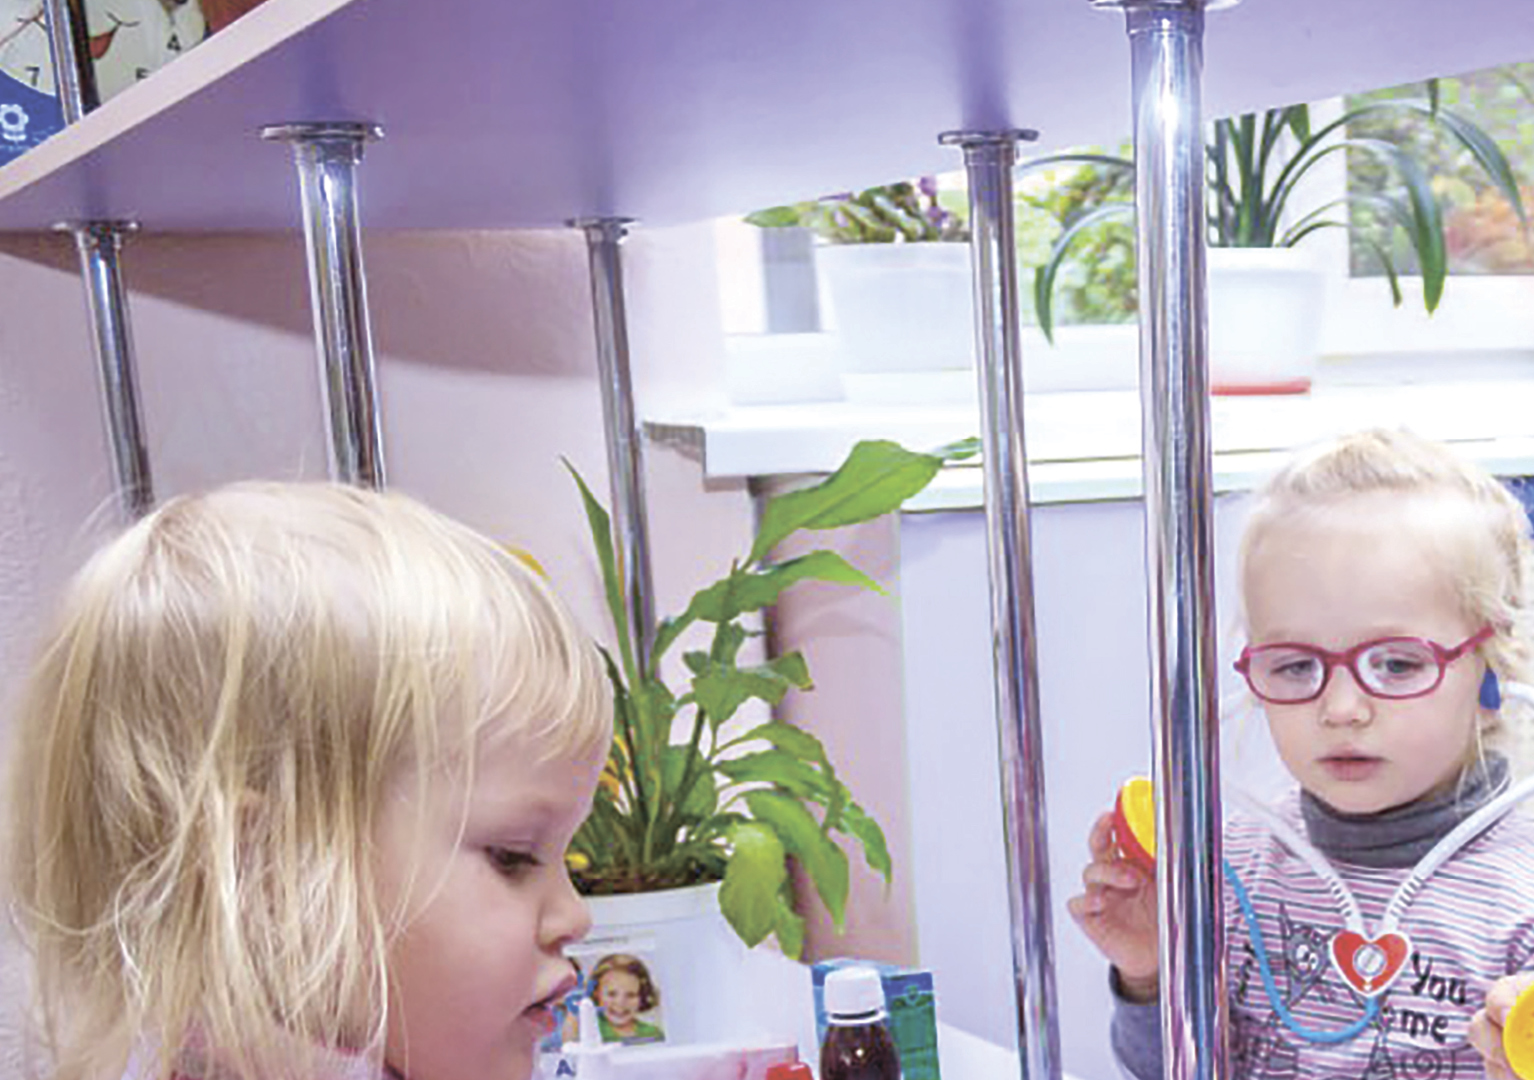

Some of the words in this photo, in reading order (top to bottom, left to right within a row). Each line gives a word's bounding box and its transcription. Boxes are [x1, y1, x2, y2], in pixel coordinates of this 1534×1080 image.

[25, 66, 40, 86] 7
[1411, 950, 1466, 1005] You
[1401, 1008, 1448, 1044] me
